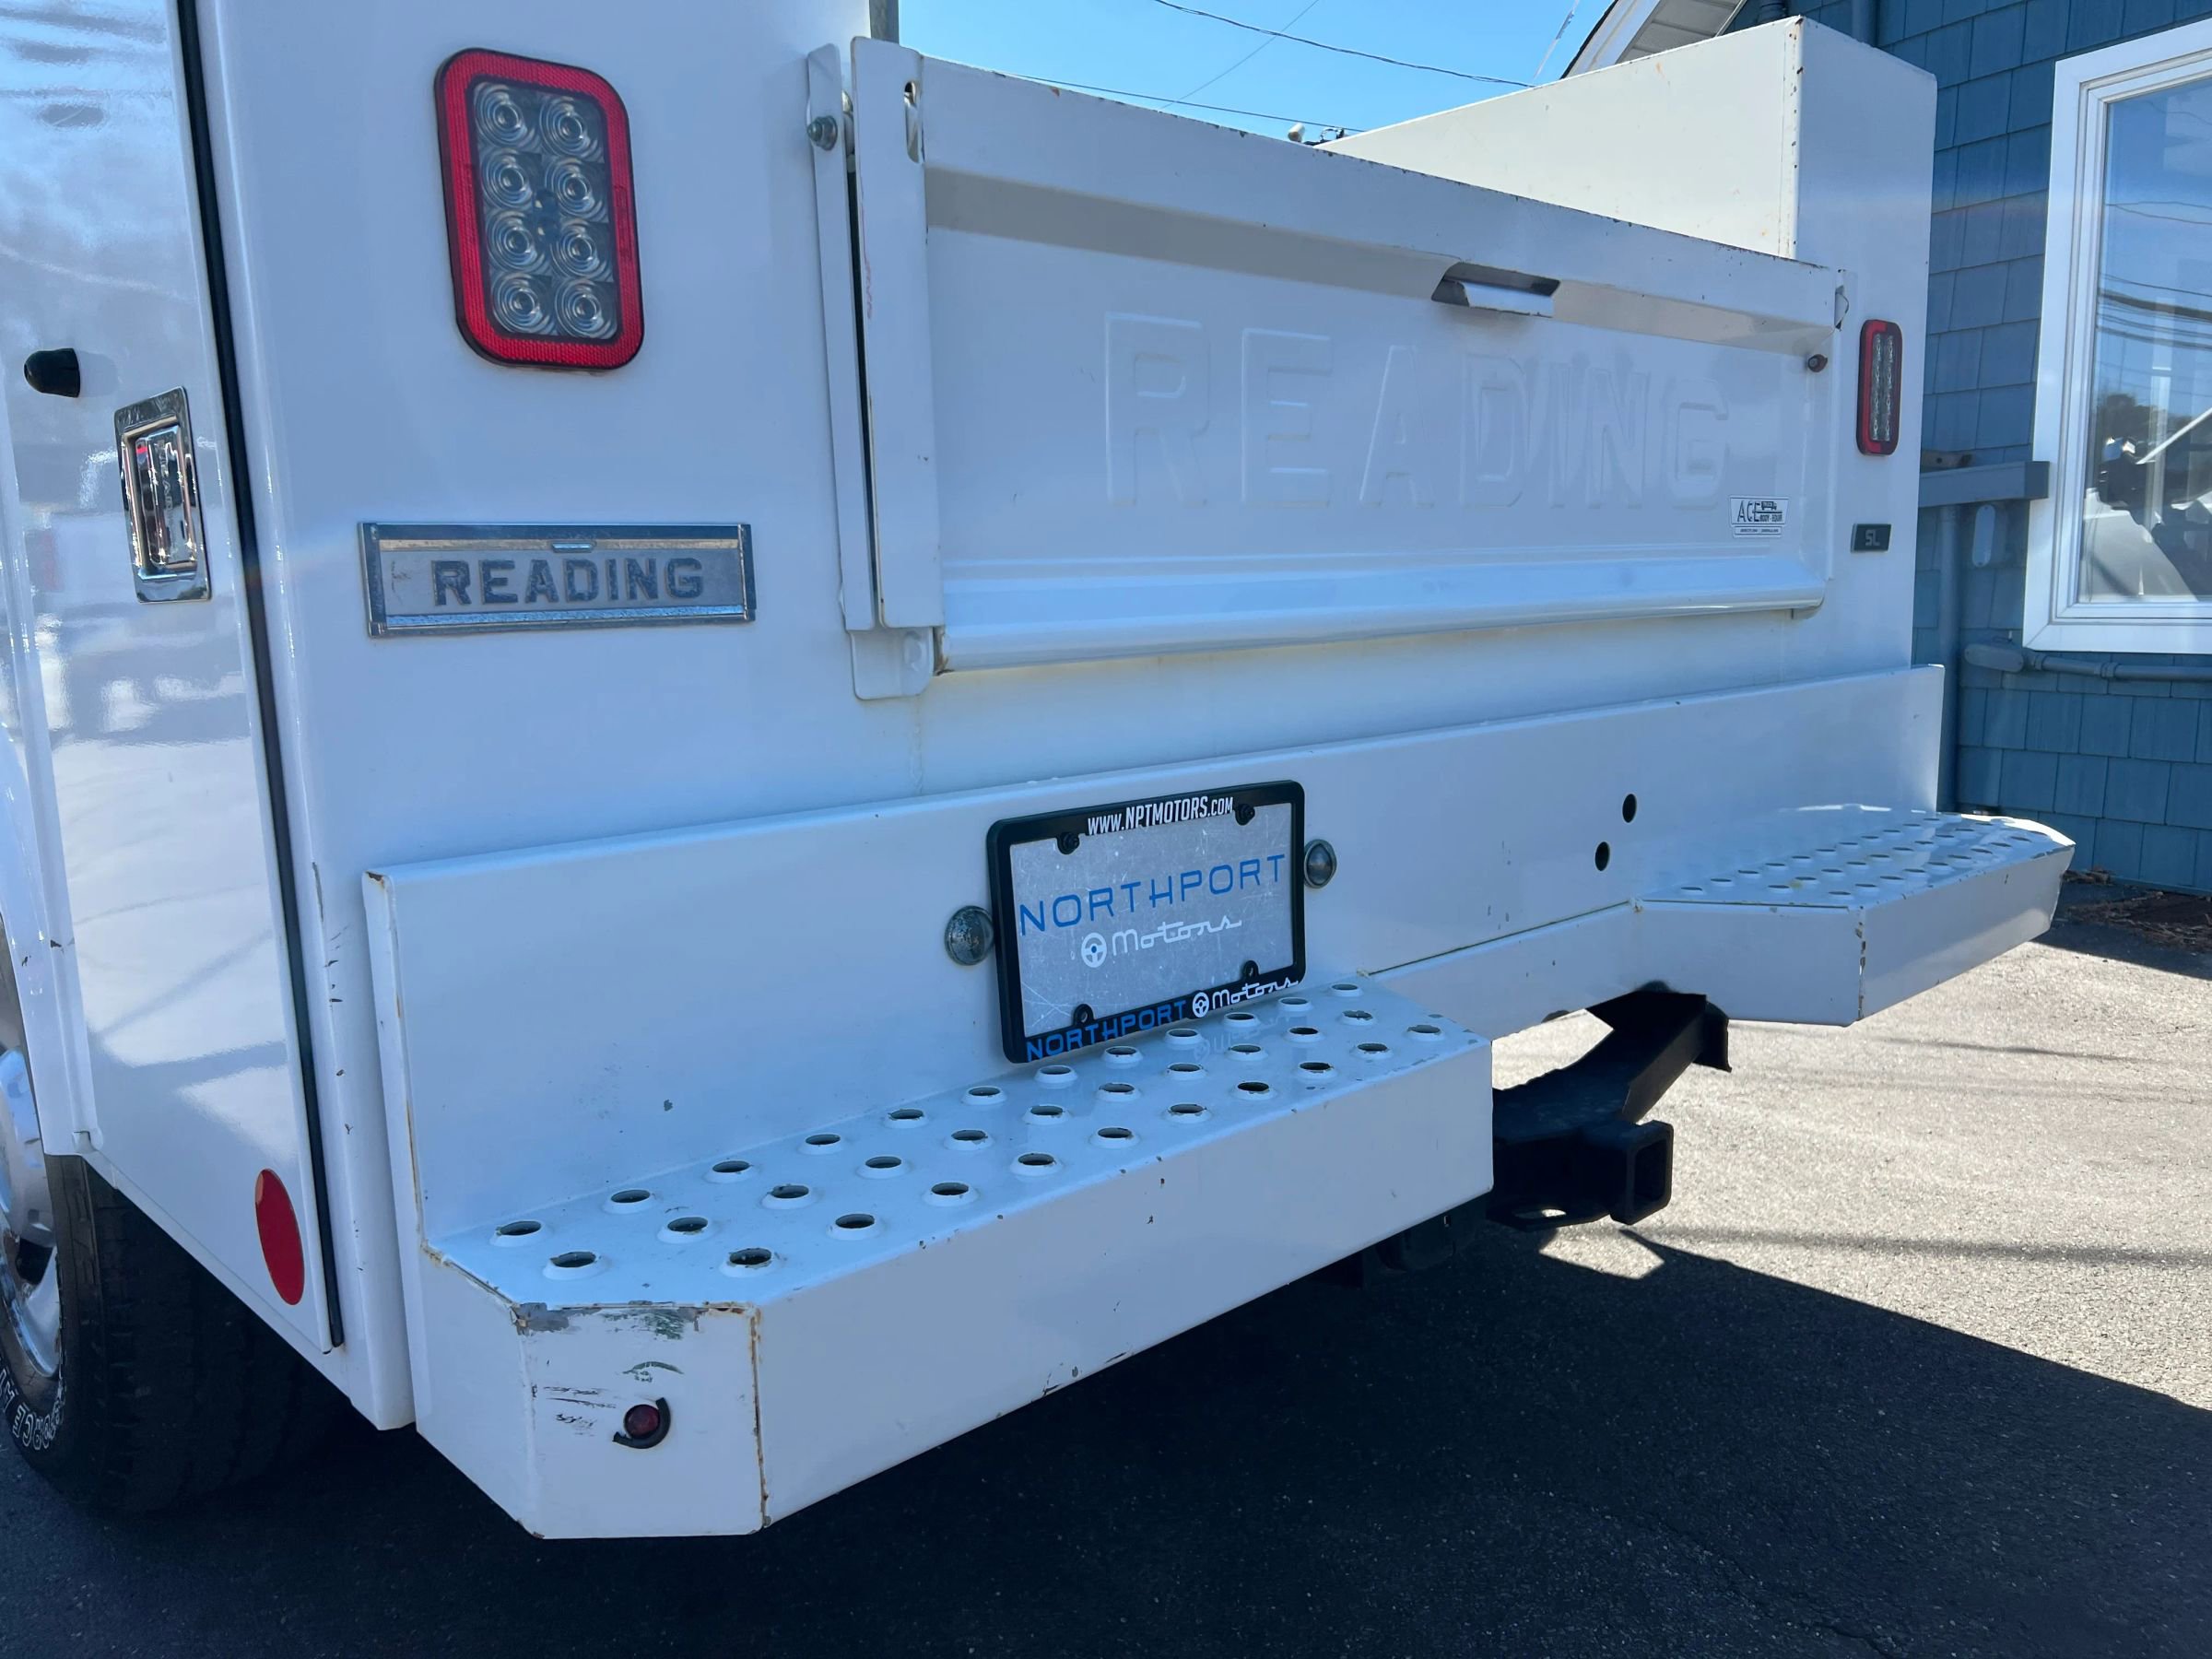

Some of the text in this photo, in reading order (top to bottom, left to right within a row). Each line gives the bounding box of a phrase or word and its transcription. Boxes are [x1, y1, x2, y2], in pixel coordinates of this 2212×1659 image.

[1105, 312, 1730, 509] READING
[1737, 500, 1760, 523] ACE
[1865, 529, 1880, 547] SL
[430, 557, 704, 606] READING
[1088, 796, 1234, 835] WWW.NPTMOTORS.COM
[1018, 853, 1286, 936] NORTHPORT
[1027, 1000, 1187, 1063] NORTHPORT
